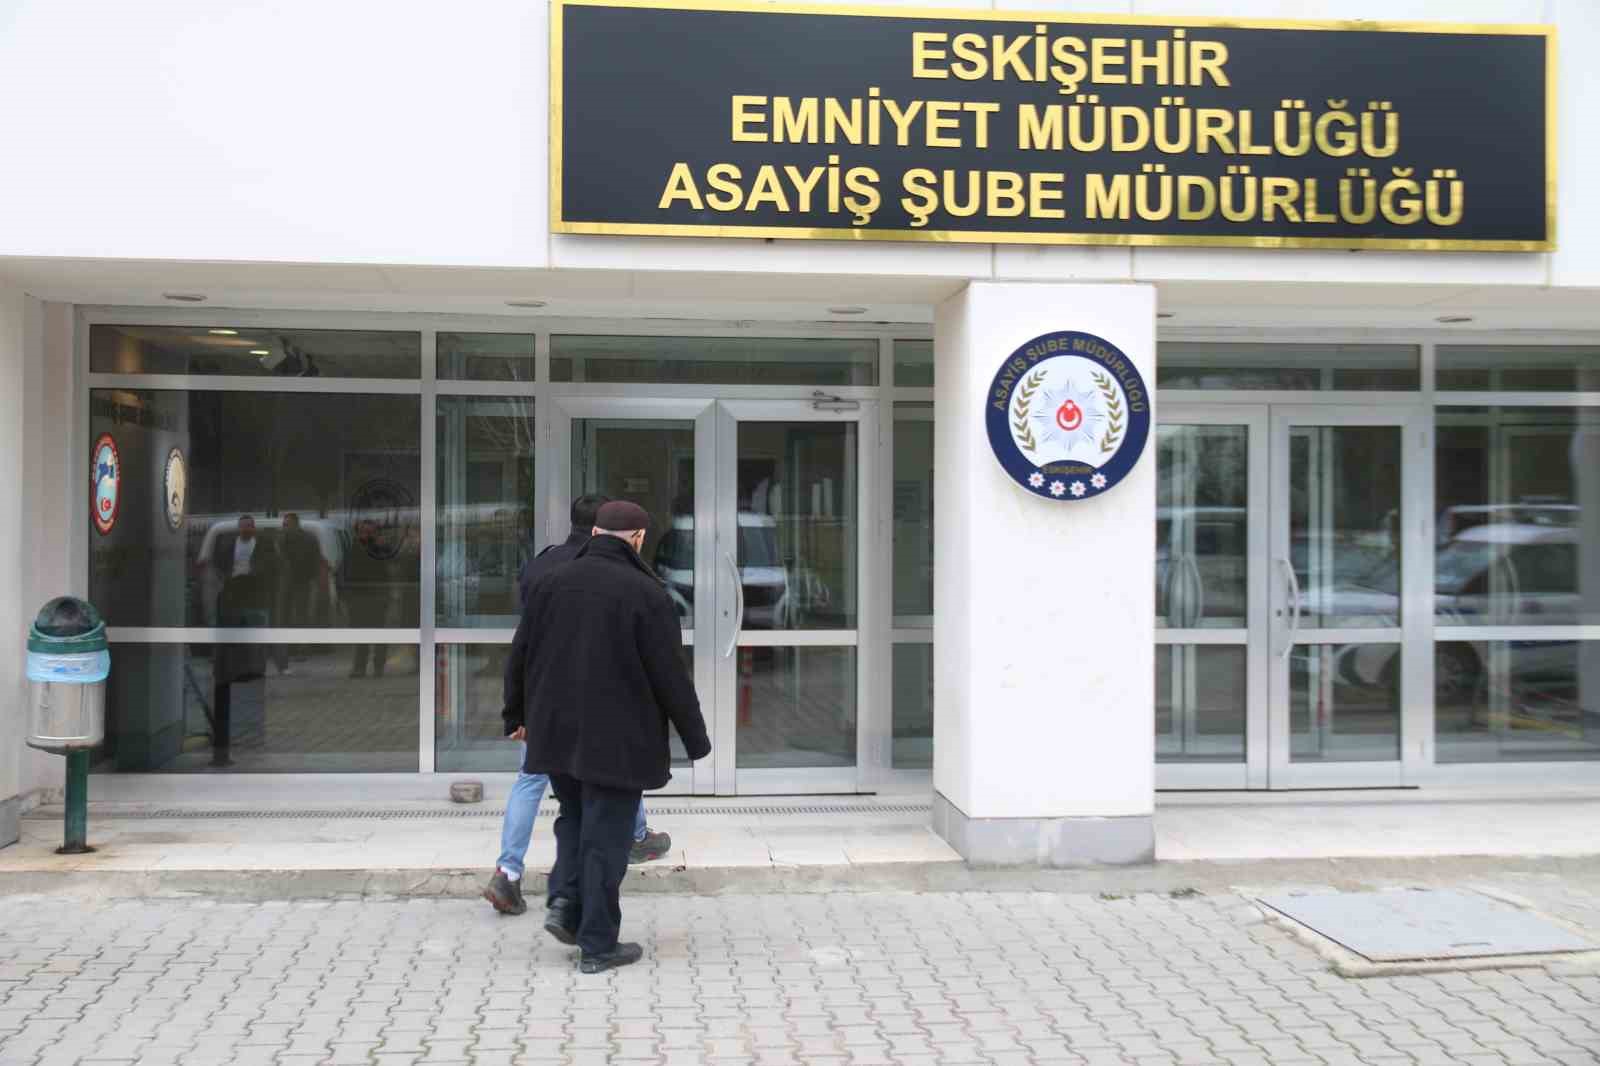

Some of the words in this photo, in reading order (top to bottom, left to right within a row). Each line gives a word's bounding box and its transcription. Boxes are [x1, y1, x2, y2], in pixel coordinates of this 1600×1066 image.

[912, 24, 1231, 94] ESKİŞEHİR
[732, 87, 1000, 149] EMNİYET
[1018, 94, 1399, 158] MÜDÜRLÜĞÜ
[659, 154, 881, 226] ASAYİŞ
[901, 167, 1066, 227] ŞUBE
[1085, 164, 1464, 226] MÜDÜRLÜĞÜ
